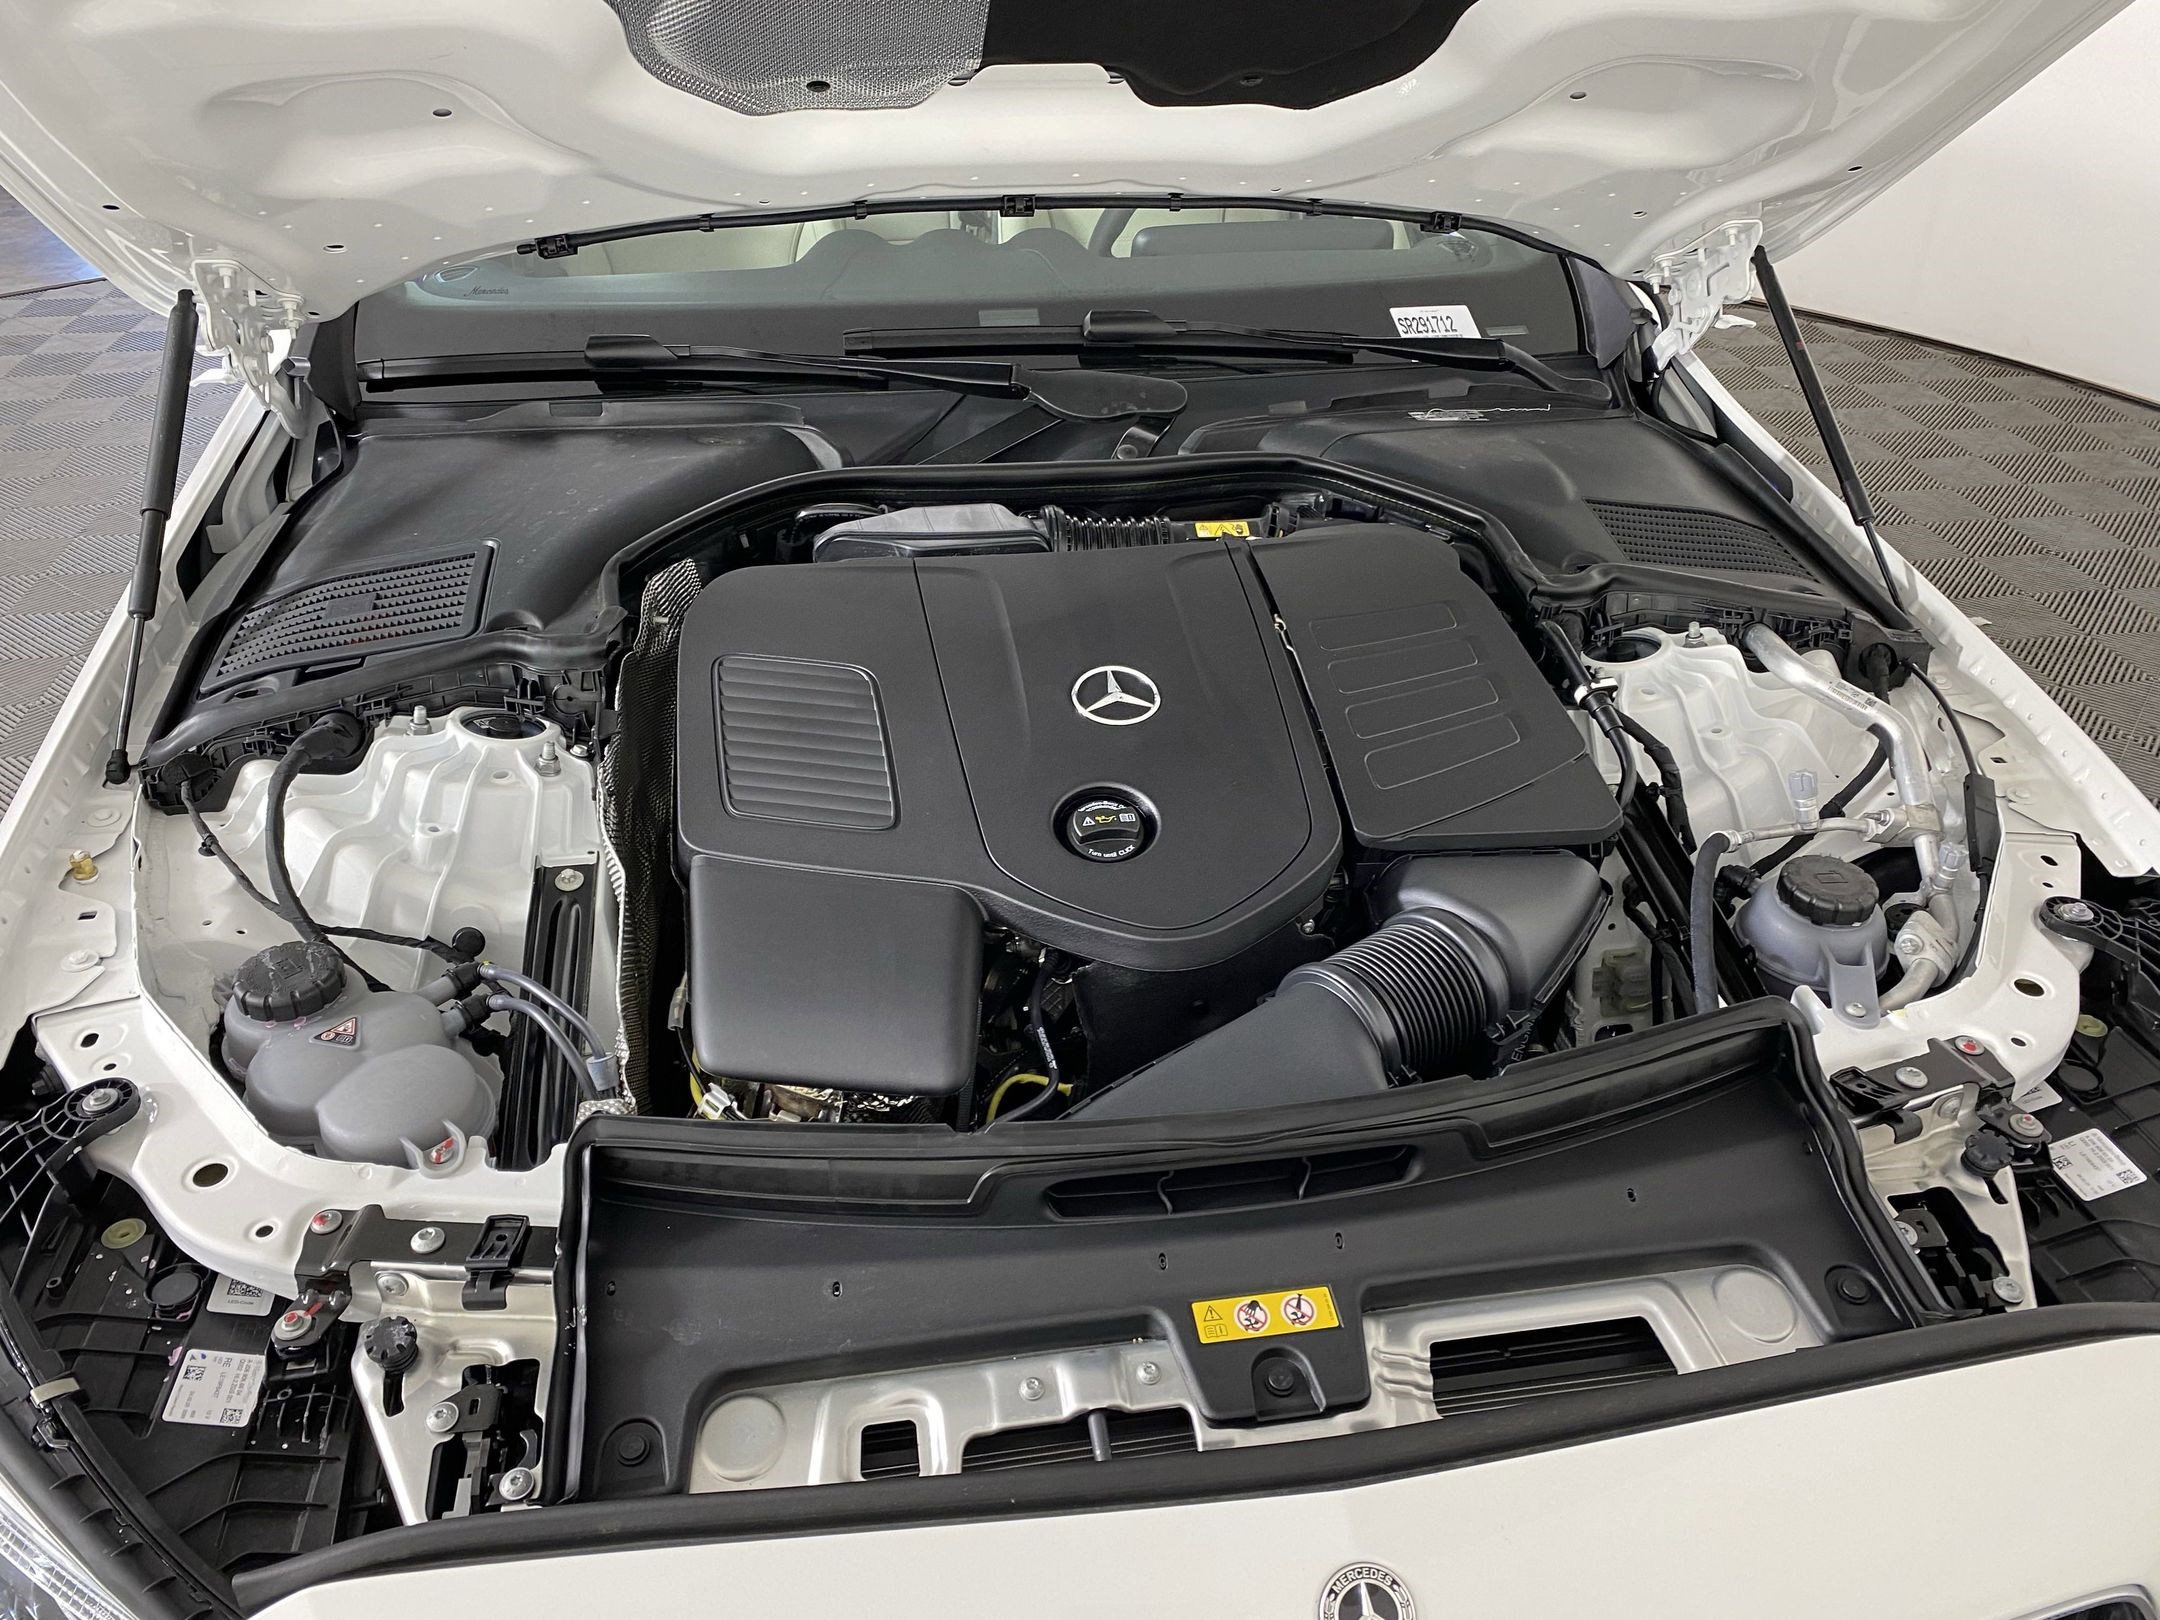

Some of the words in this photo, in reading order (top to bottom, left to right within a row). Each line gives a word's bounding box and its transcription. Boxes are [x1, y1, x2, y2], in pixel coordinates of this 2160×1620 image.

[1397, 315, 1458, 334] SR291712
[1088, 848, 1102, 857] Turn
[1118, 844, 1135, 857] CLICK
[1331, 1567, 1394, 1594] MERCEDES
